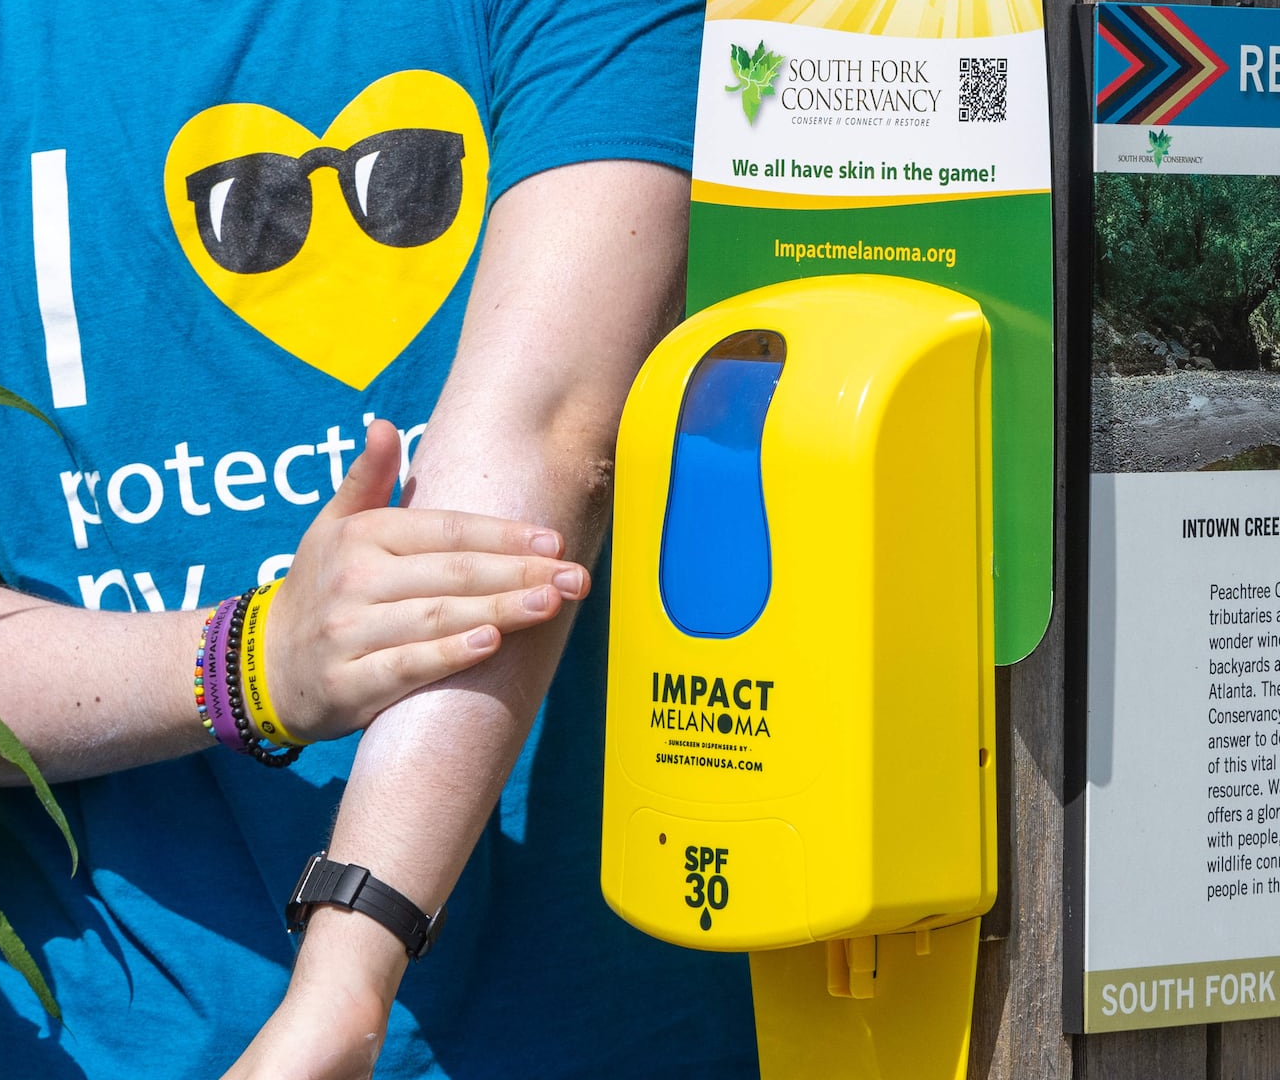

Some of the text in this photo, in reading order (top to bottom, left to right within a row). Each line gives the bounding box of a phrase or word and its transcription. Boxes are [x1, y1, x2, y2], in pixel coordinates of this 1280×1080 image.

[789, 58, 929, 84] SOUTH FORK
[781, 88, 942, 112] CONSERVANCY
[792, 116, 930, 127] CONSERVE CONNECT RESTORE
[733, 159, 996, 185] We all have skin in the game!
[775, 239, 956, 267] Impactmelanoma.org
[31, 148, 87, 408] I
[1183, 518, 1239, 538] INTOWN
[1210, 584, 1270, 600] Peachtree
[1209, 607, 1272, 625] tributaries
[1209, 633, 1253, 649] wonder
[248, 605, 262, 710] HOPE LIVES HERE
[1210, 657, 1269, 677] backyards
[653, 672, 774, 711] IMPACT
[1209, 682, 1256, 700] Atlanta.
[650, 708, 770, 738] MELANOMA
[669, 740, 699, 748] SUNSCREEN
[702, 742, 737, 751] DISPENSERS
[656, 753, 763, 772] SUNSTATIONUSA.COM
[685, 845, 728, 873] SPF
[685, 873, 728, 909] 30
[1102, 977, 1194, 1016] SOUTH
[1205, 971, 1276, 1006] FORK
